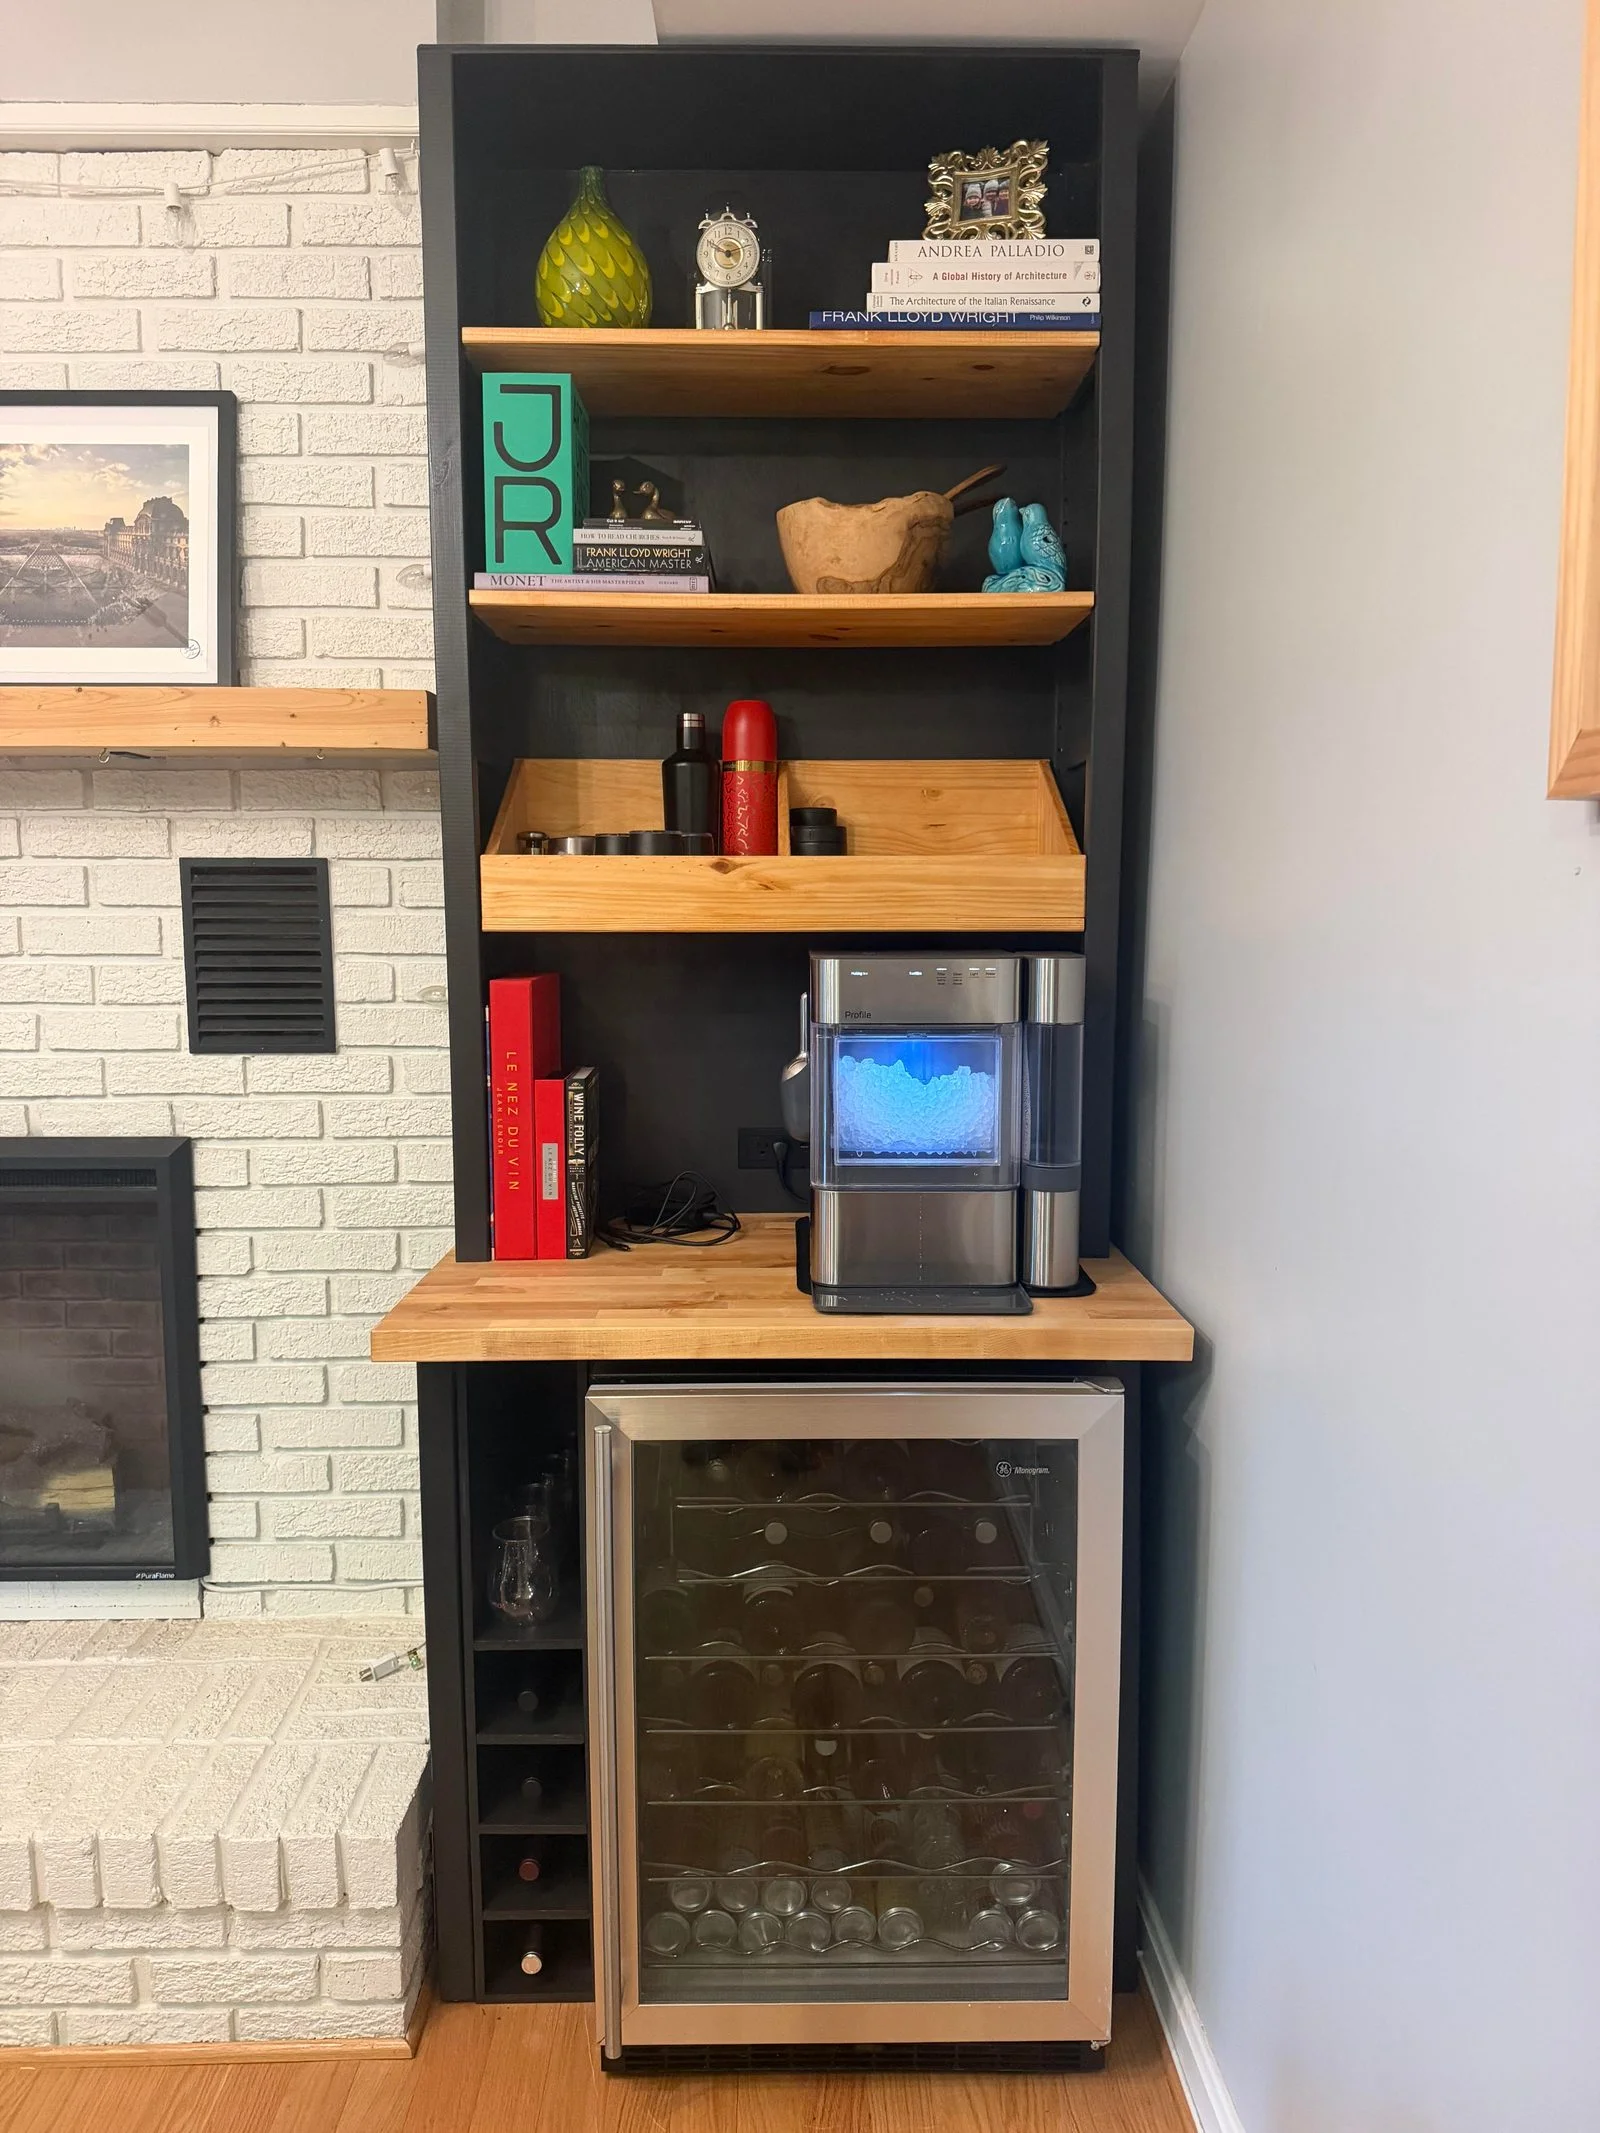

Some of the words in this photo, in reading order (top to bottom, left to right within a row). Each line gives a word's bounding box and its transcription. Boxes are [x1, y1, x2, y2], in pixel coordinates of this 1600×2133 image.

[714, 230, 721, 238] 11
[724, 226, 733, 236] 12
[917, 245, 983, 258] ANDREA
[990, 244, 1065, 257] PALLADIO
[932, 272, 939, 280] A
[941, 272, 968, 281] Global
[971, 272, 1001, 282] History
[1004, 272, 1012, 280] of
[1015, 271, 1068, 280] Architecture
[890, 296, 904, 306] The
[905, 296, 956, 306] Architecture
[958, 296, 967, 306] of
[969, 297, 982, 306] the
[984, 296, 1008, 306] Italian
[1010, 296, 1056, 306] Renaissance
[822, 311, 882, 323] FRANK
[887, 311, 943, 323] LLOYD
[949, 311, 1017, 324] WRIGHT
[493, 384, 563, 565] JR
[586, 547, 617, 557] FRANK
[619, 547, 651, 558] LLOYD
[652, 548, 692, 558] WRIGHT
[586, 558, 646, 568] AMERICAN
[649, 559, 692, 569] MASTER
[489, 575, 547, 587] MONET
[844, 1010, 872, 1020] Profile
[506, 1051, 518, 1072] LE
[507, 1082, 518, 1116] NEZ
[573, 1092, 584, 1122] WINE
[508, 1126, 519, 1148] DU
[573, 1125, 584, 1155] FOLLY
[508, 1157, 519, 1190] VIN
[140, 1571, 175, 1579] PuraFlame
